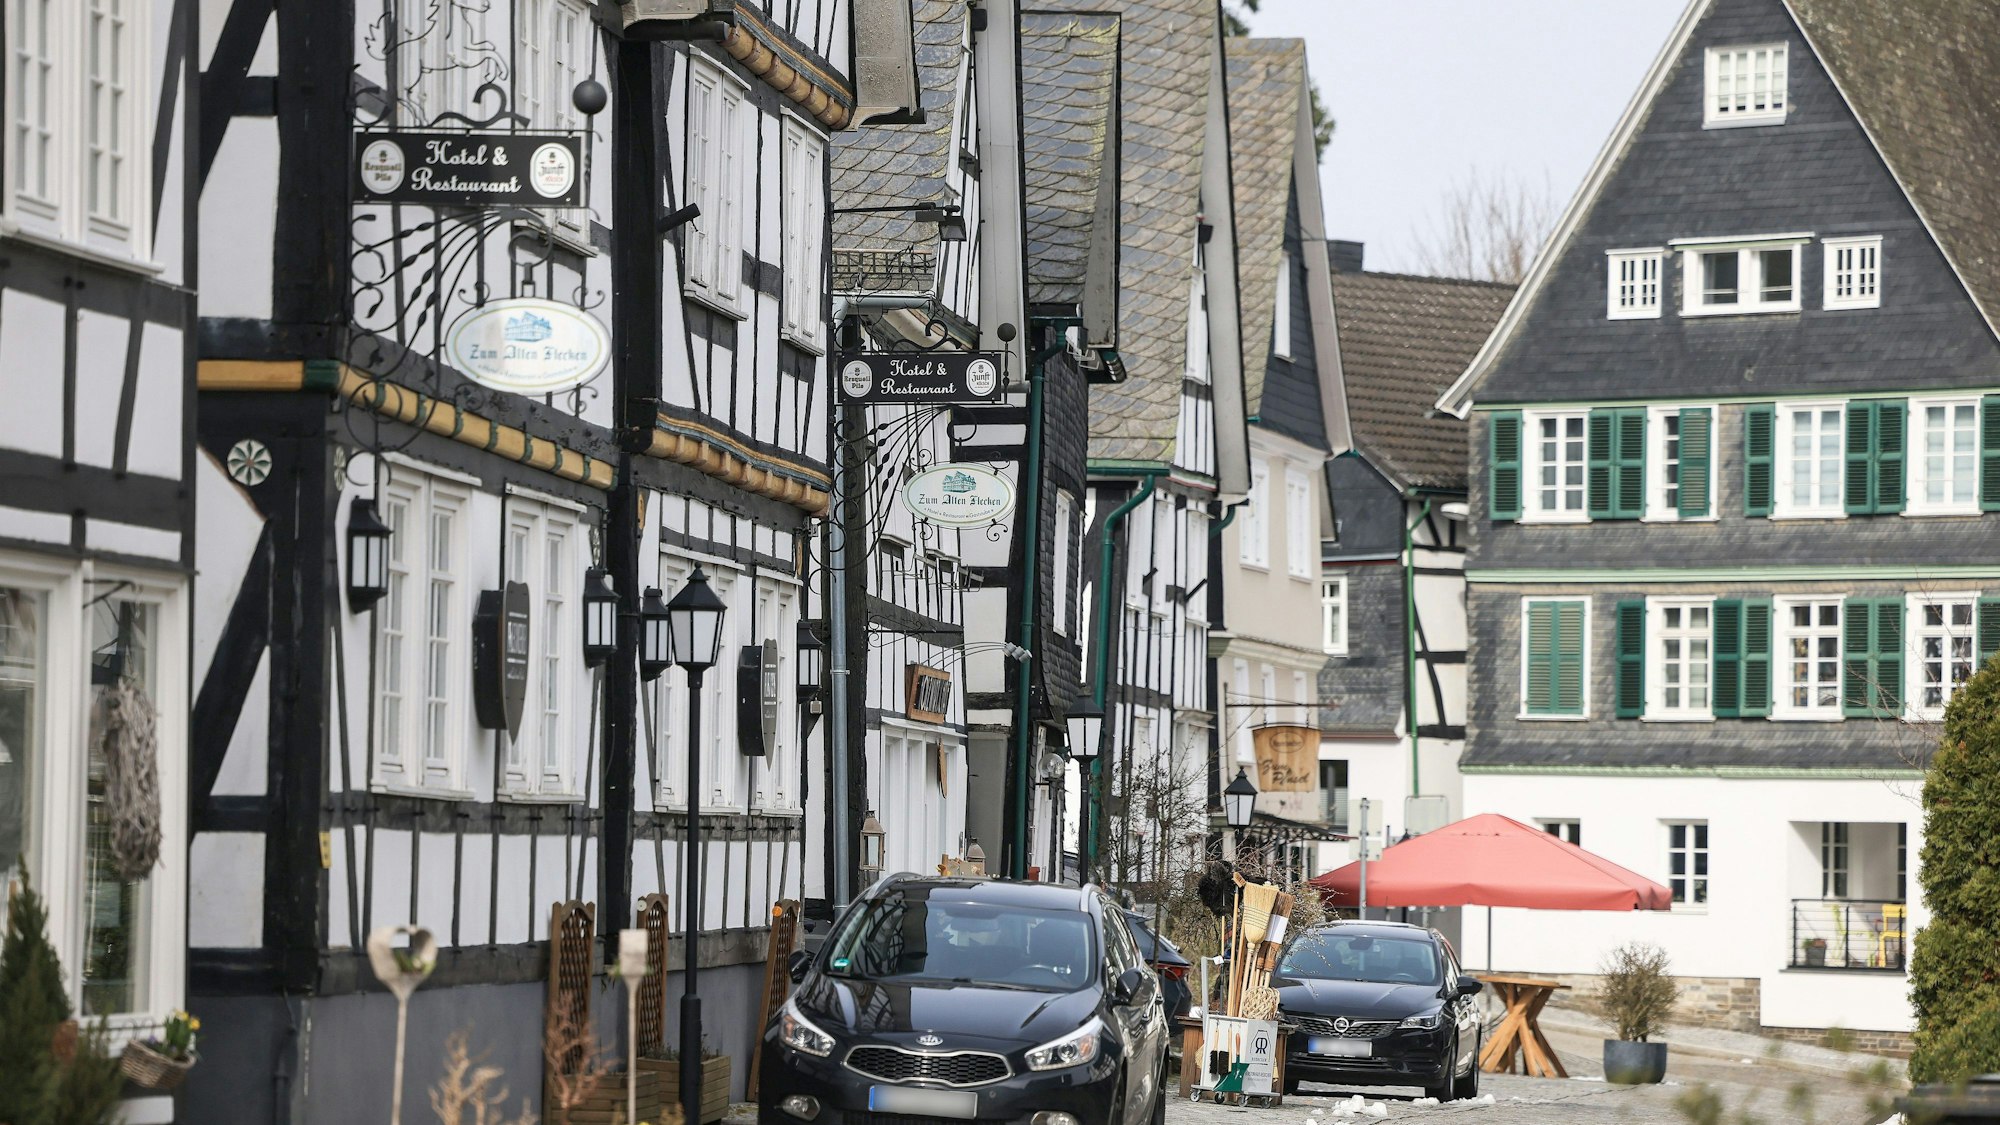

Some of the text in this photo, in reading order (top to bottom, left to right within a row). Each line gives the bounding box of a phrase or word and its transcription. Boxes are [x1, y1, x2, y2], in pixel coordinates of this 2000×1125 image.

[425, 140, 508, 166] Hotel &
[411, 166, 522, 193] Restaurant
[469, 344, 587, 360] Zum Alten Flecken
[889, 359, 947, 376] Hotel &
[880, 377, 956, 395] Restaurant
[918, 493, 1001, 506] Zum Alten Flecken
